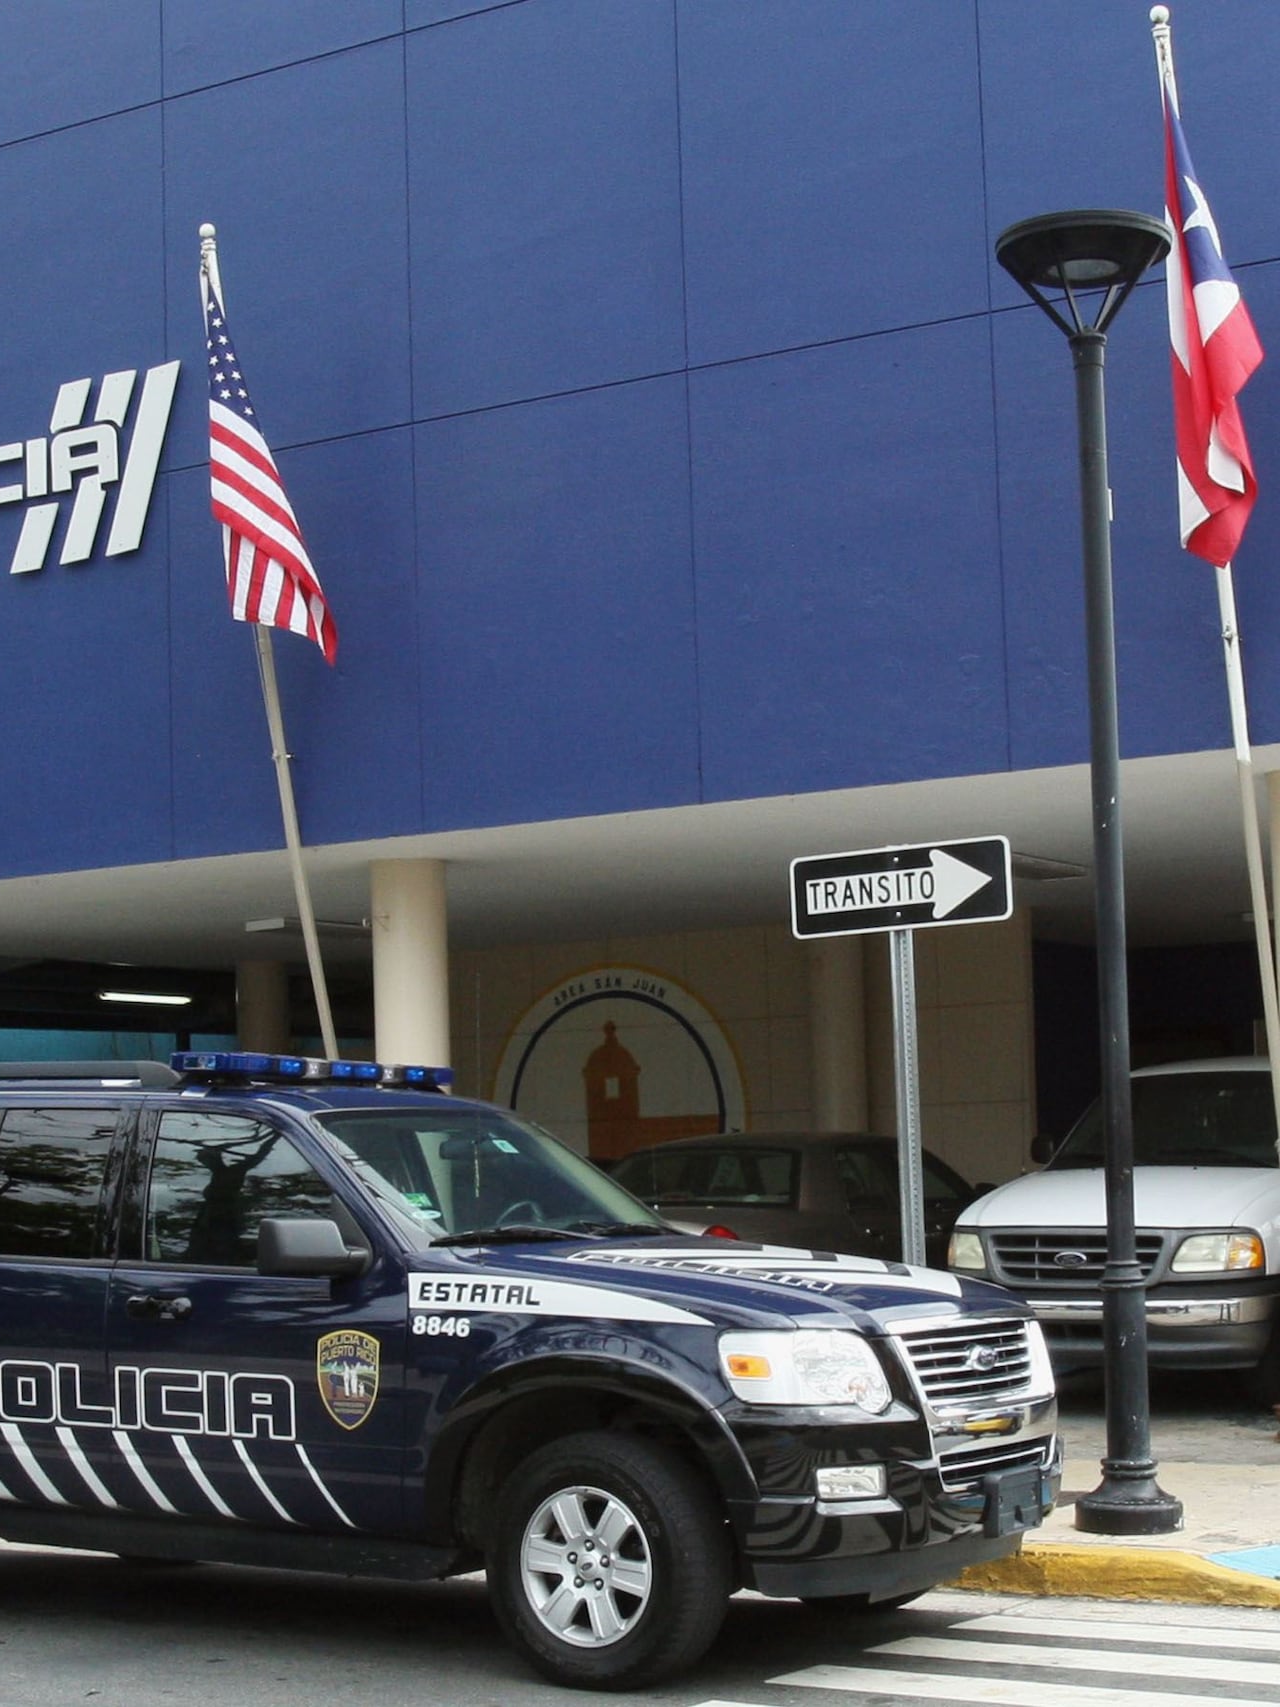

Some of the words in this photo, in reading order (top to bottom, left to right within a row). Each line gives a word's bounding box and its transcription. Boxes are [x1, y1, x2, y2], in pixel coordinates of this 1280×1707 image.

[809, 870, 935, 910] TRANSITO
[632, 977, 668, 999] JUAN
[419, 1282, 541, 1306] ESTATAL
[412, 1315, 470, 1338] 8846
[321, 1334, 360, 1350] POLICIA
[362, 1337, 377, 1352] DE
[321, 1345, 355, 1362] PUERTO
[356, 1346, 377, 1364] RICO
